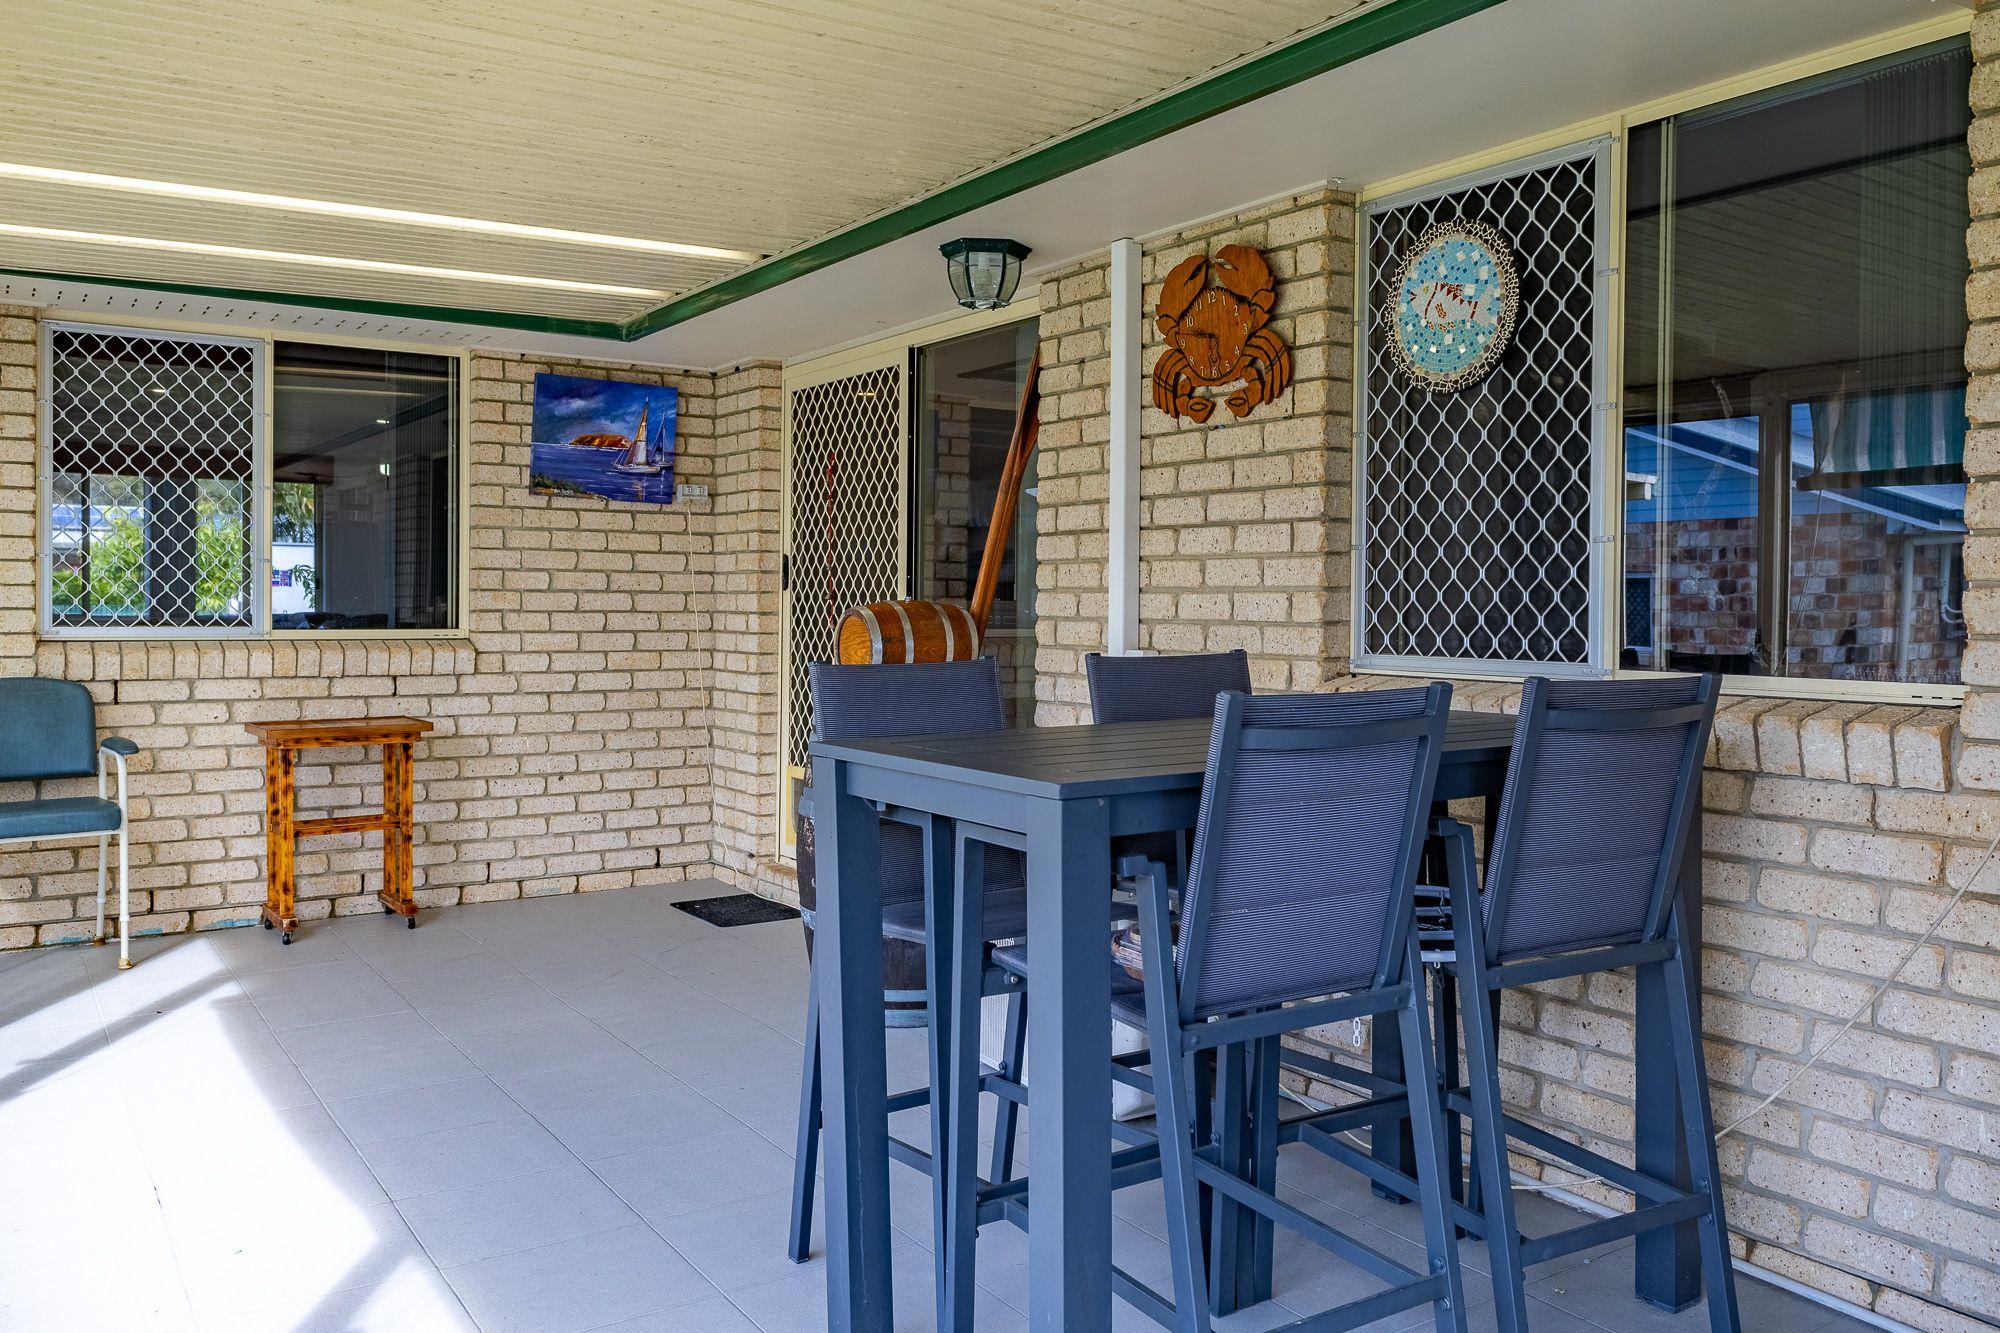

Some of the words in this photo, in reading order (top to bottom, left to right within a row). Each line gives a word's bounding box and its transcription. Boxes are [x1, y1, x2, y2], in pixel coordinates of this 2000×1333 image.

[1207, 291, 1217, 304] 12
[1195, 299, 1202, 312] 11
[1233, 305, 1239, 316] 2
[1186, 316, 1194, 327] 10
[1243, 323, 1248, 335] 3
[1180, 339, 1186, 349] 9
[1234, 345, 1239, 356] 4
[1189, 355, 1194, 366] 8
[1225, 360, 1231, 372] 5
[1200, 366, 1204, 377] 7
[1212, 367, 1217, 377] 6
